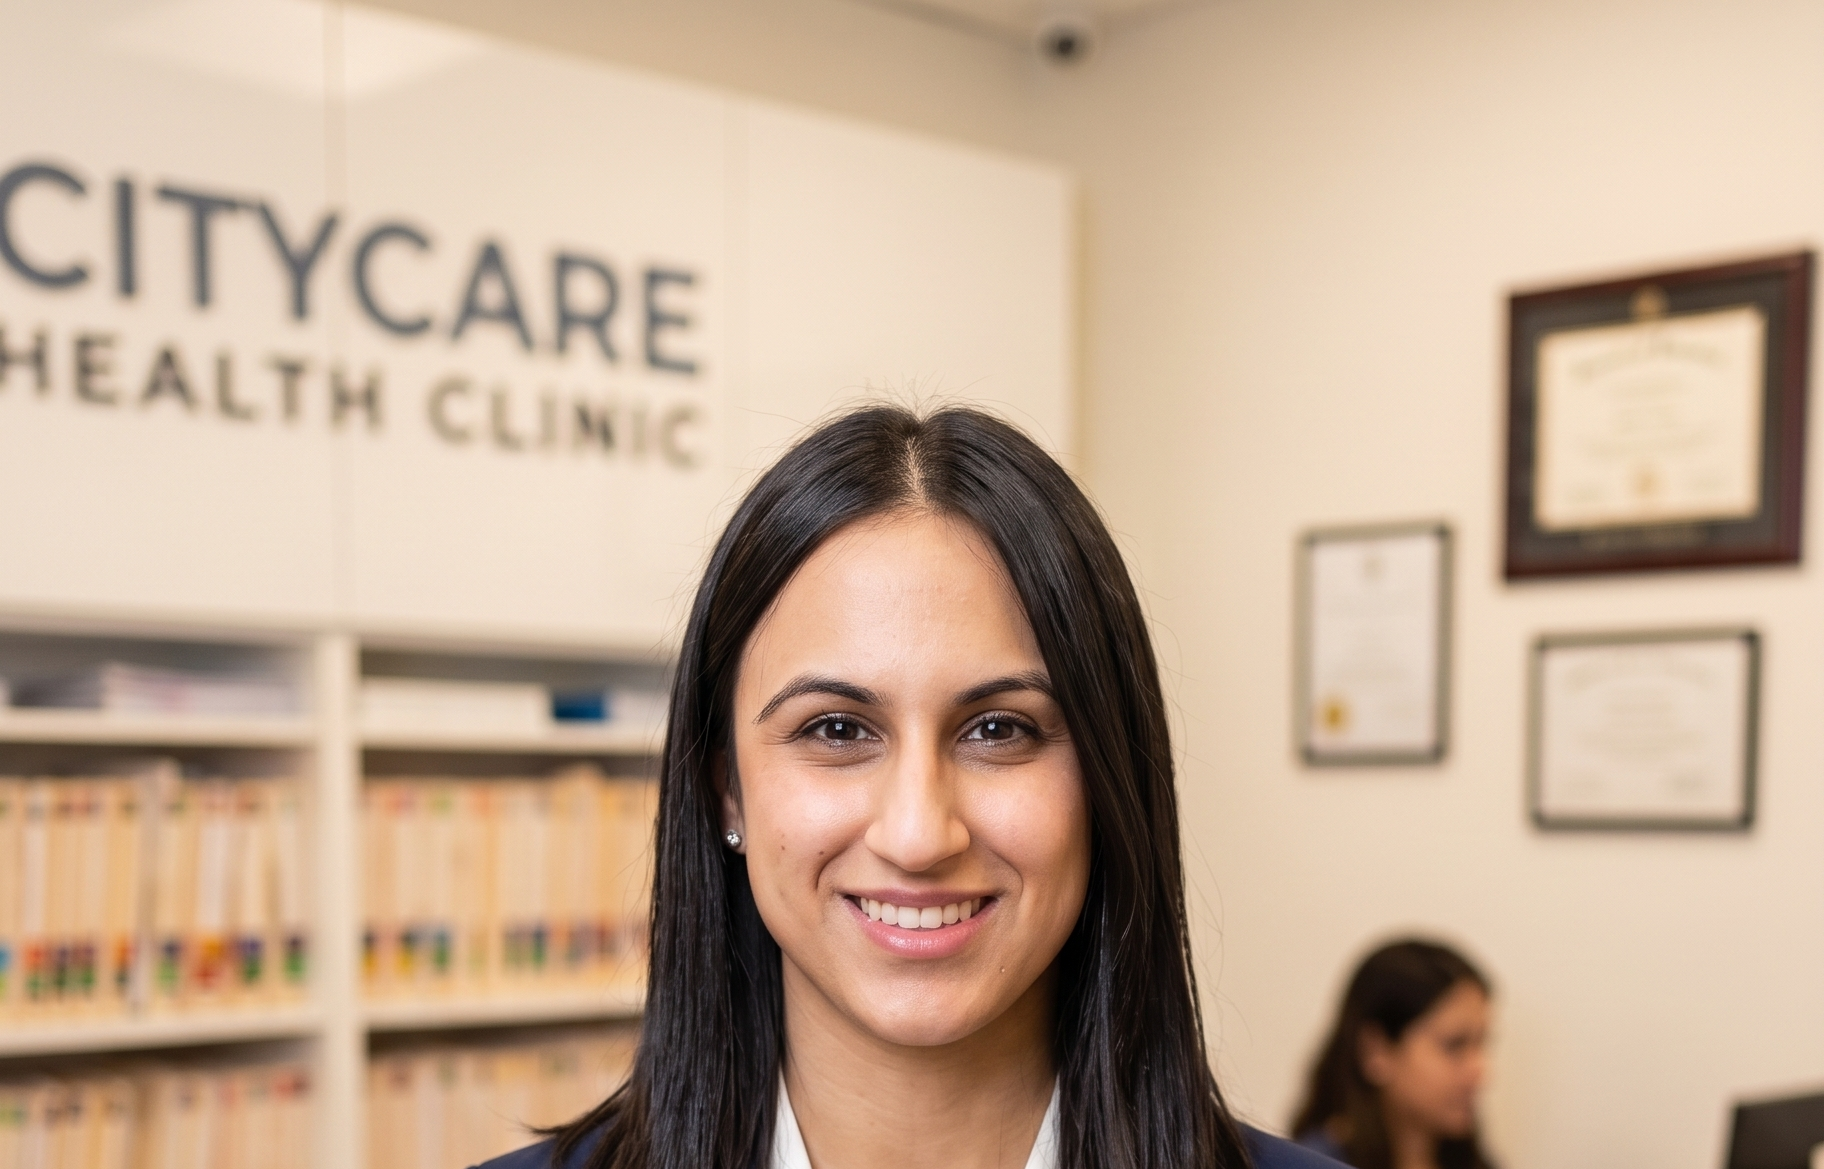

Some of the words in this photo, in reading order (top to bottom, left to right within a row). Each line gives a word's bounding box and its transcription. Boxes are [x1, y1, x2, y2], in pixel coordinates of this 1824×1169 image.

[0, 161, 700, 376] CITYCARE
[0, 324, 385, 432] HEALTH
[426, 376, 706, 470] CLINIC
